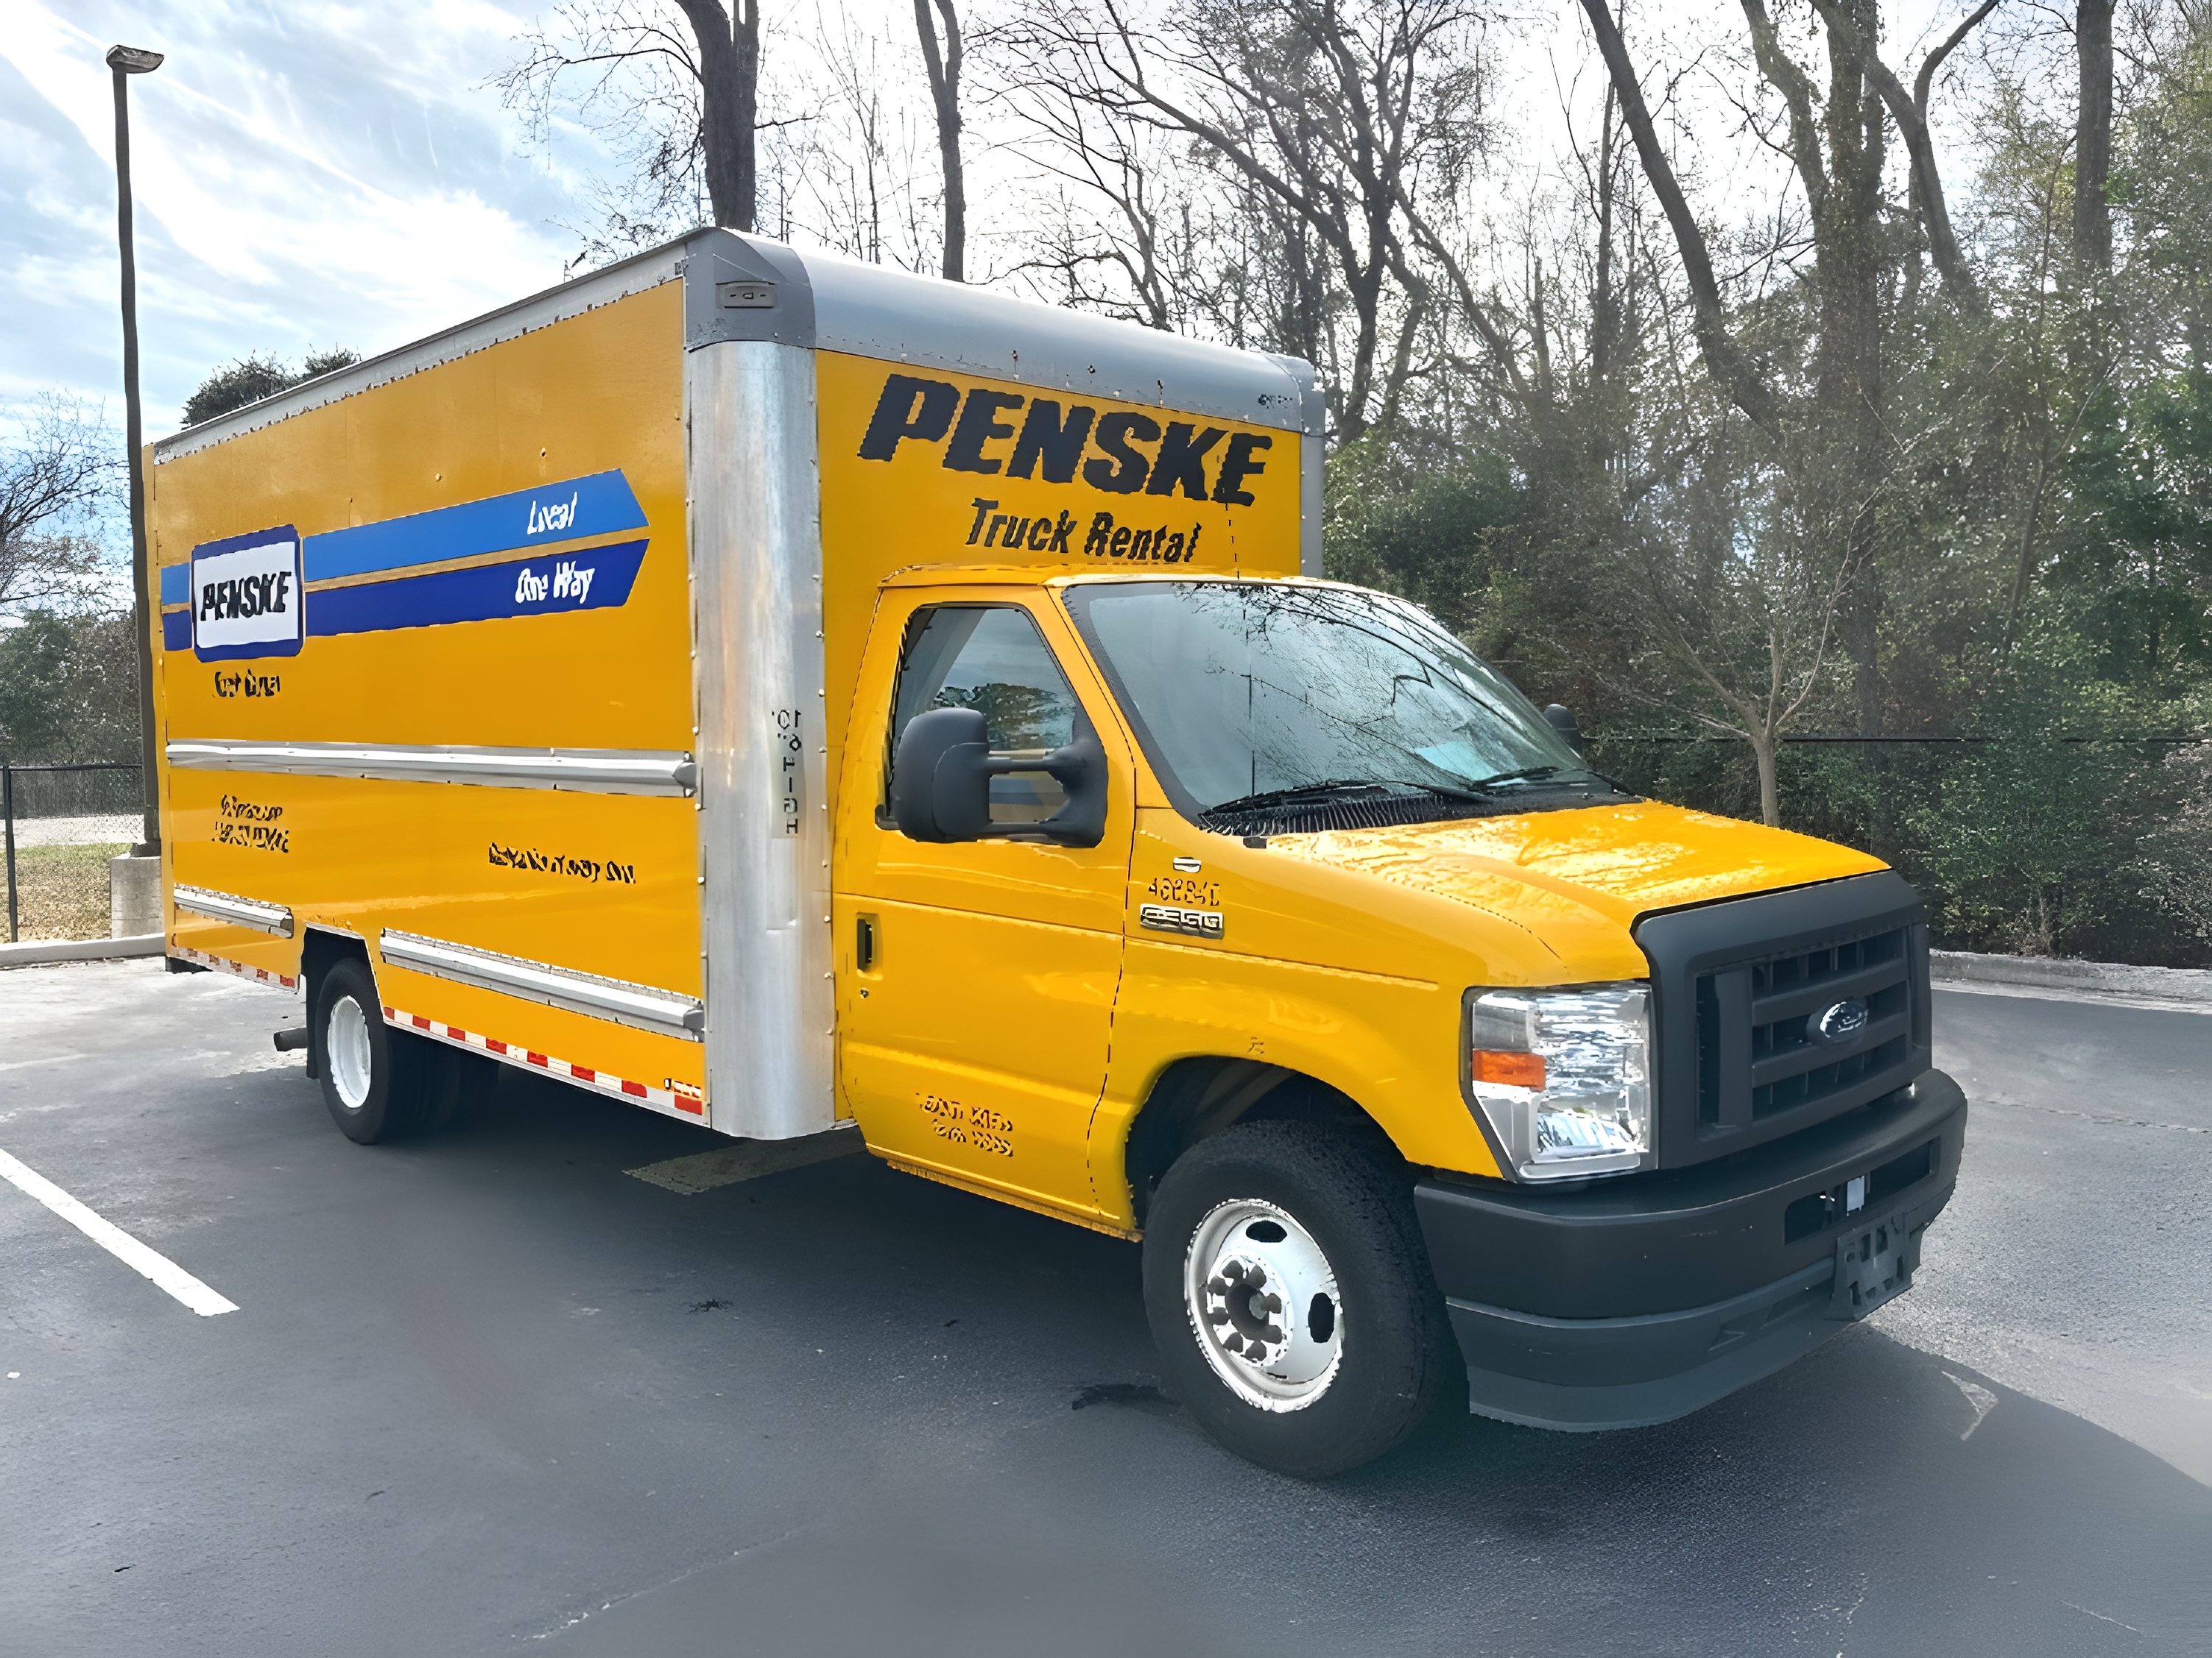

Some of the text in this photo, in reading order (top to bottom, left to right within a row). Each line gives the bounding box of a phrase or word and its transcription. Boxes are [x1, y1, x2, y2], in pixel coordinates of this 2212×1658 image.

[857, 374, 1272, 507] PENSKE
[965, 498, 1202, 562] Truck Rental
[200, 571, 292, 621] PENSKE
[554, 560, 595, 604] Way
